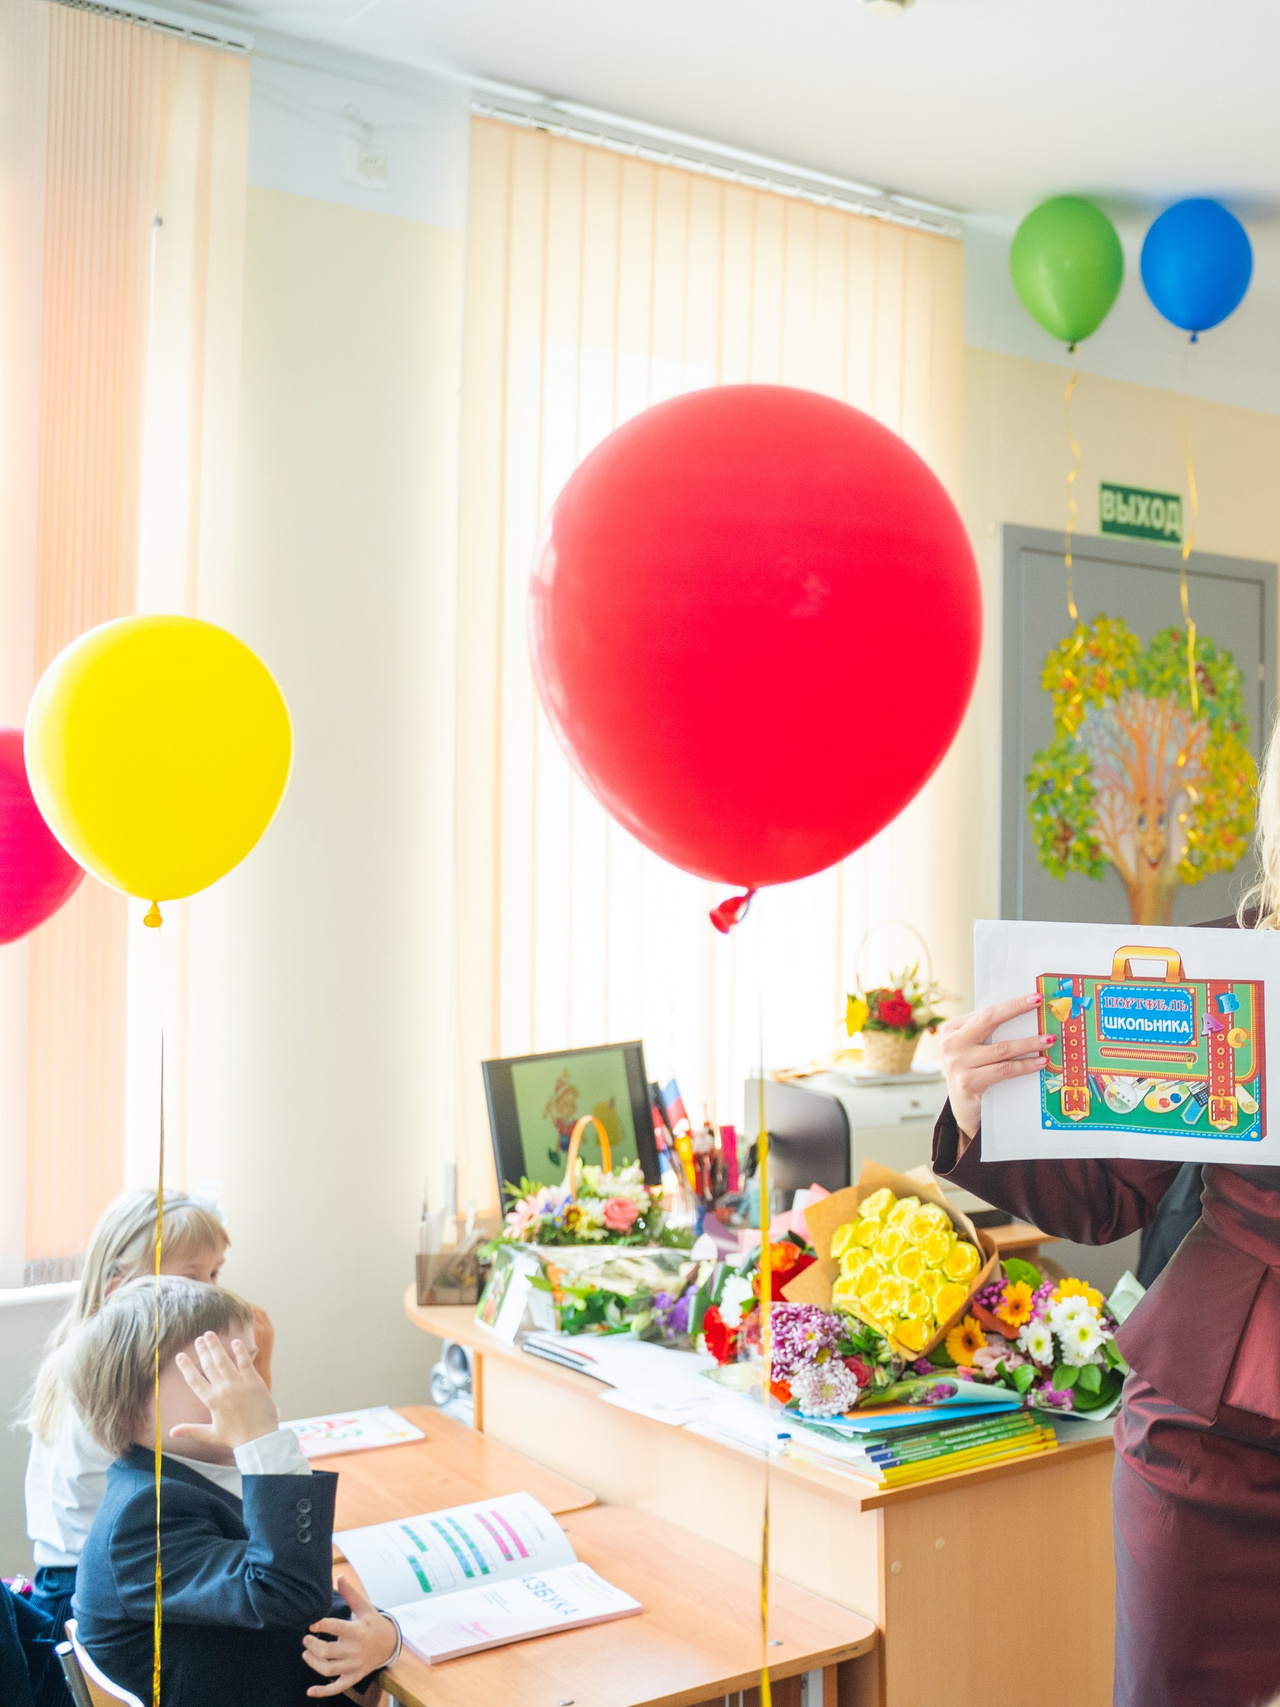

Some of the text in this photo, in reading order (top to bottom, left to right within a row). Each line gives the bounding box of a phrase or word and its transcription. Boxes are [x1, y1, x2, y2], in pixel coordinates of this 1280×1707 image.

[1102, 489, 1180, 537] ВЫХОД
[1103, 996, 1189, 1013] ПОРТФЕЛЬ
[1104, 1015, 1190, 1034] ШКОЛЬНИКА
[520, 1575, 580, 1616] АЗБУКА
